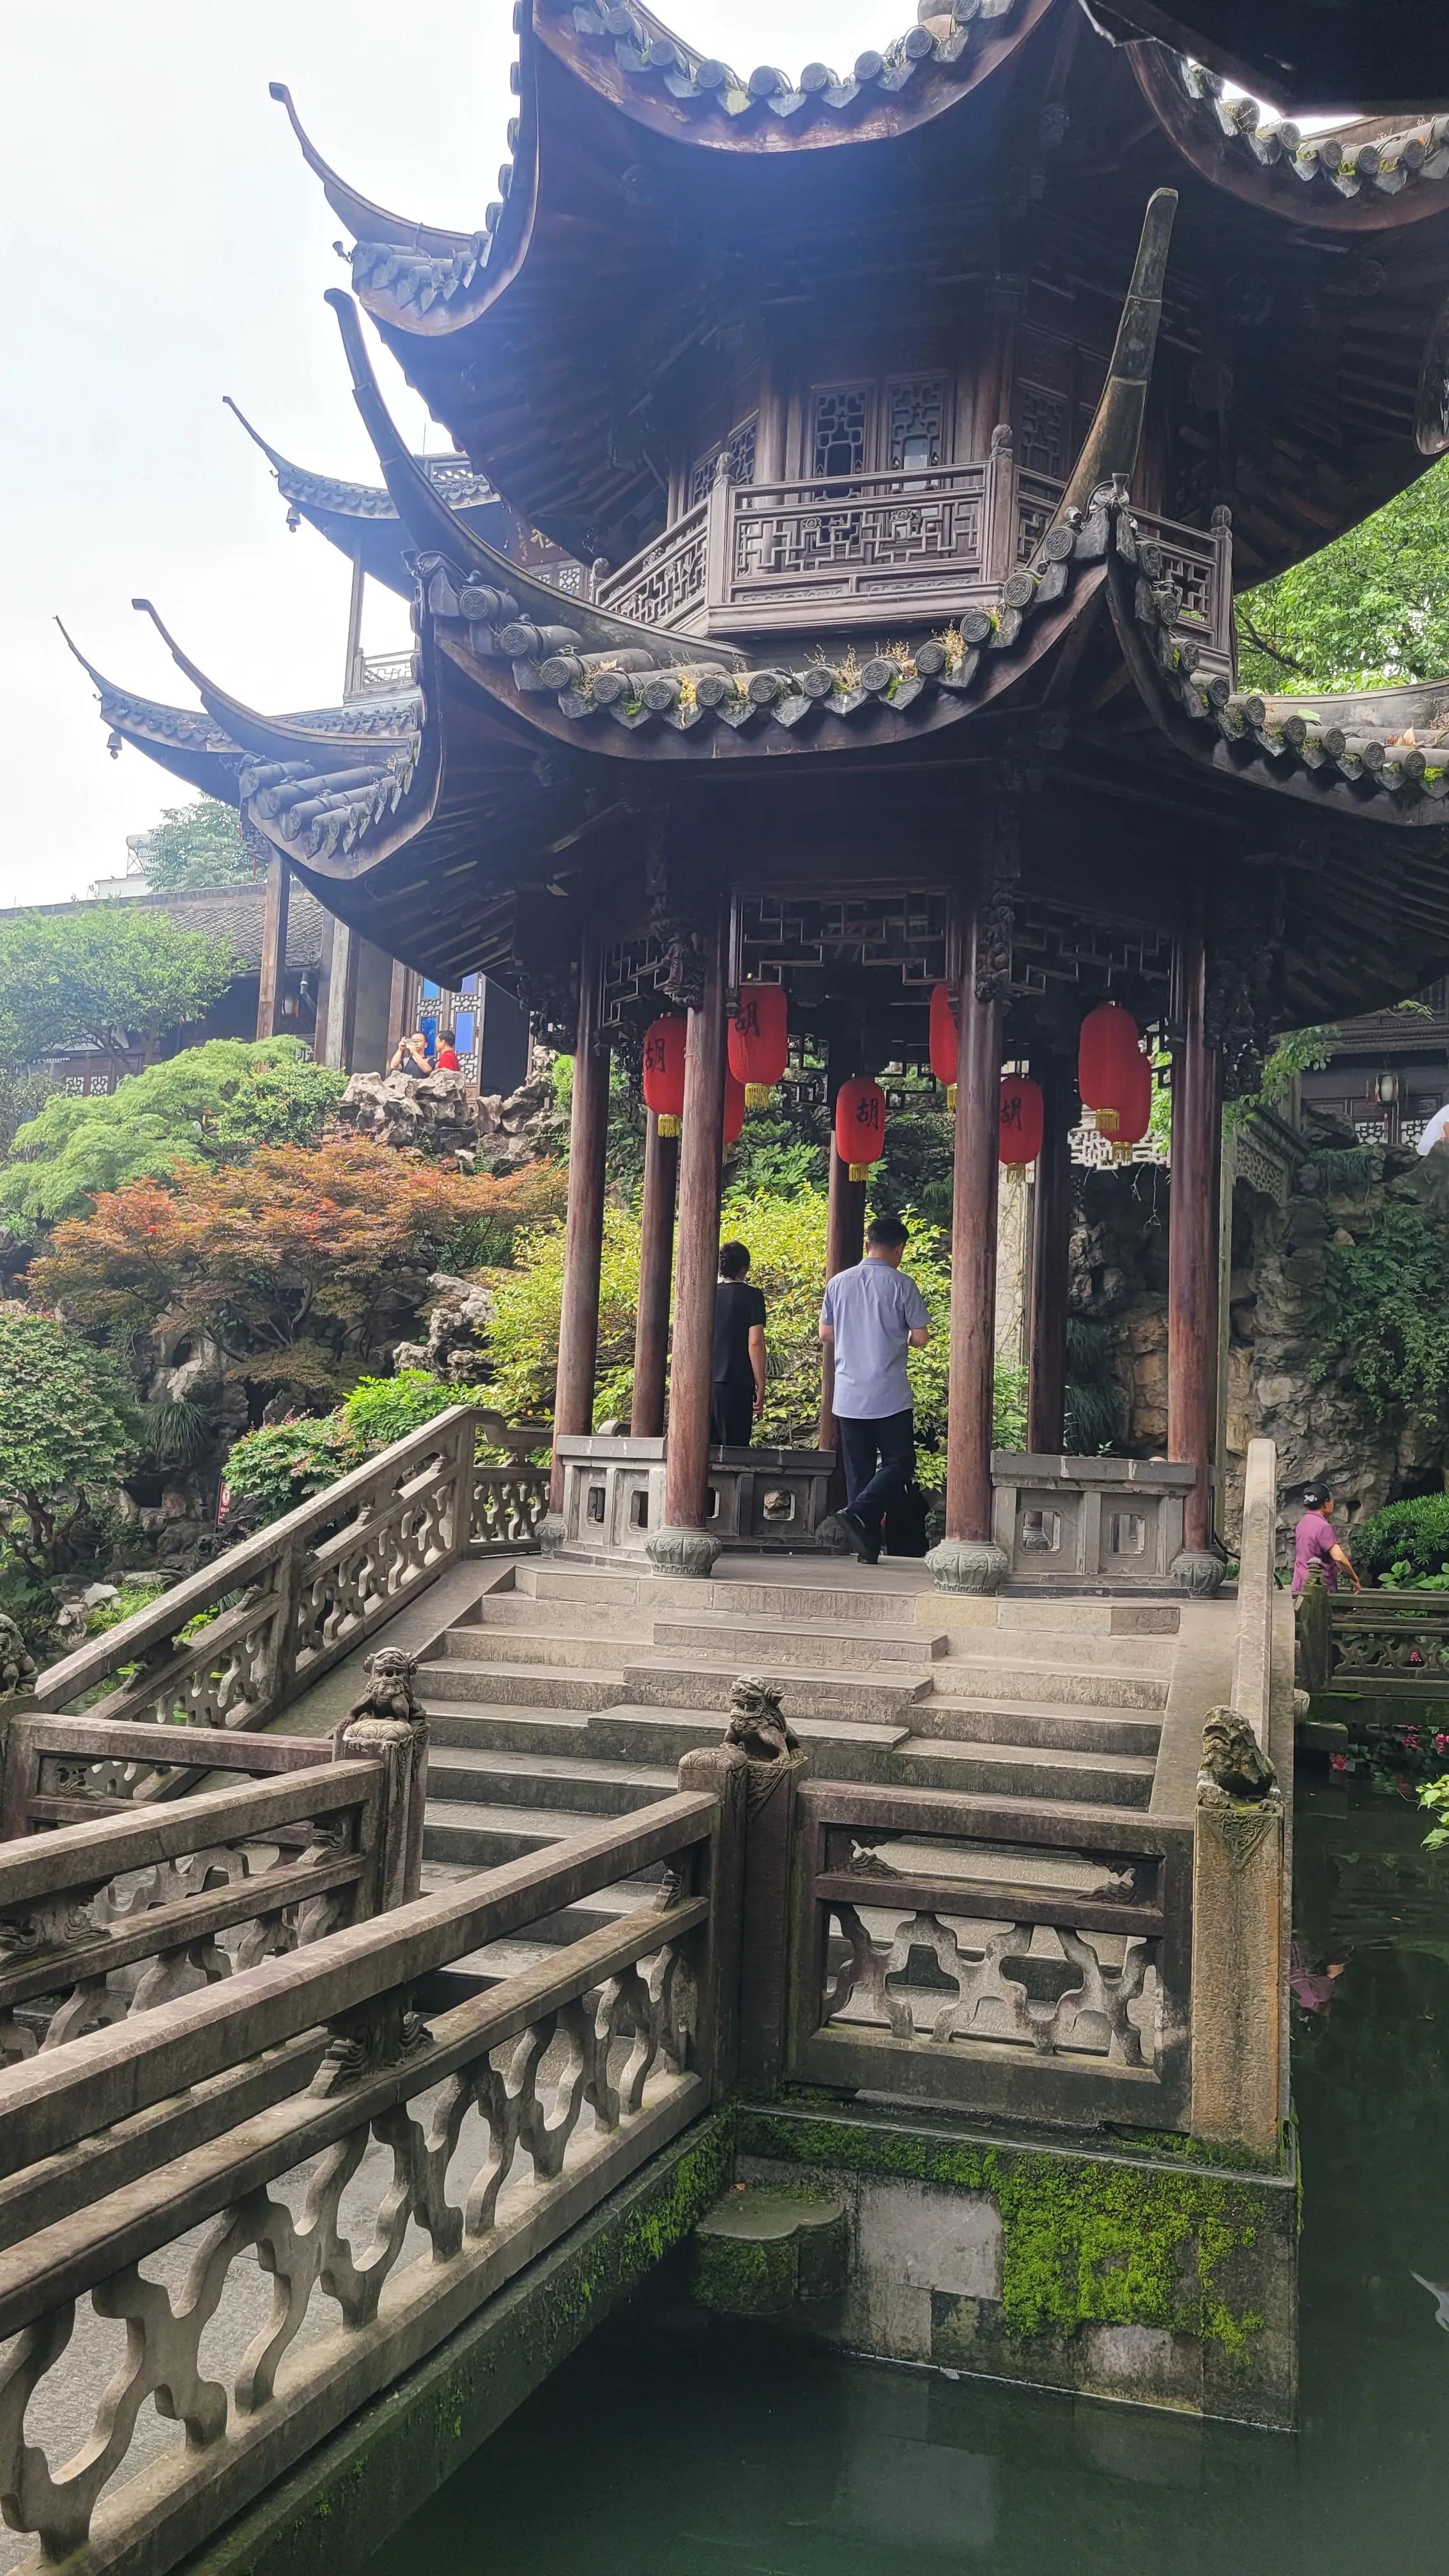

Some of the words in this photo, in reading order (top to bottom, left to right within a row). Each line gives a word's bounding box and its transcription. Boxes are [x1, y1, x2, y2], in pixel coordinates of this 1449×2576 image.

[735, 1002, 760, 1037] 胡
[645, 1038, 665, 1073] 胡
[855, 1098, 879, 1130] 胡
[1000, 1097, 1022, 1131] 胡
